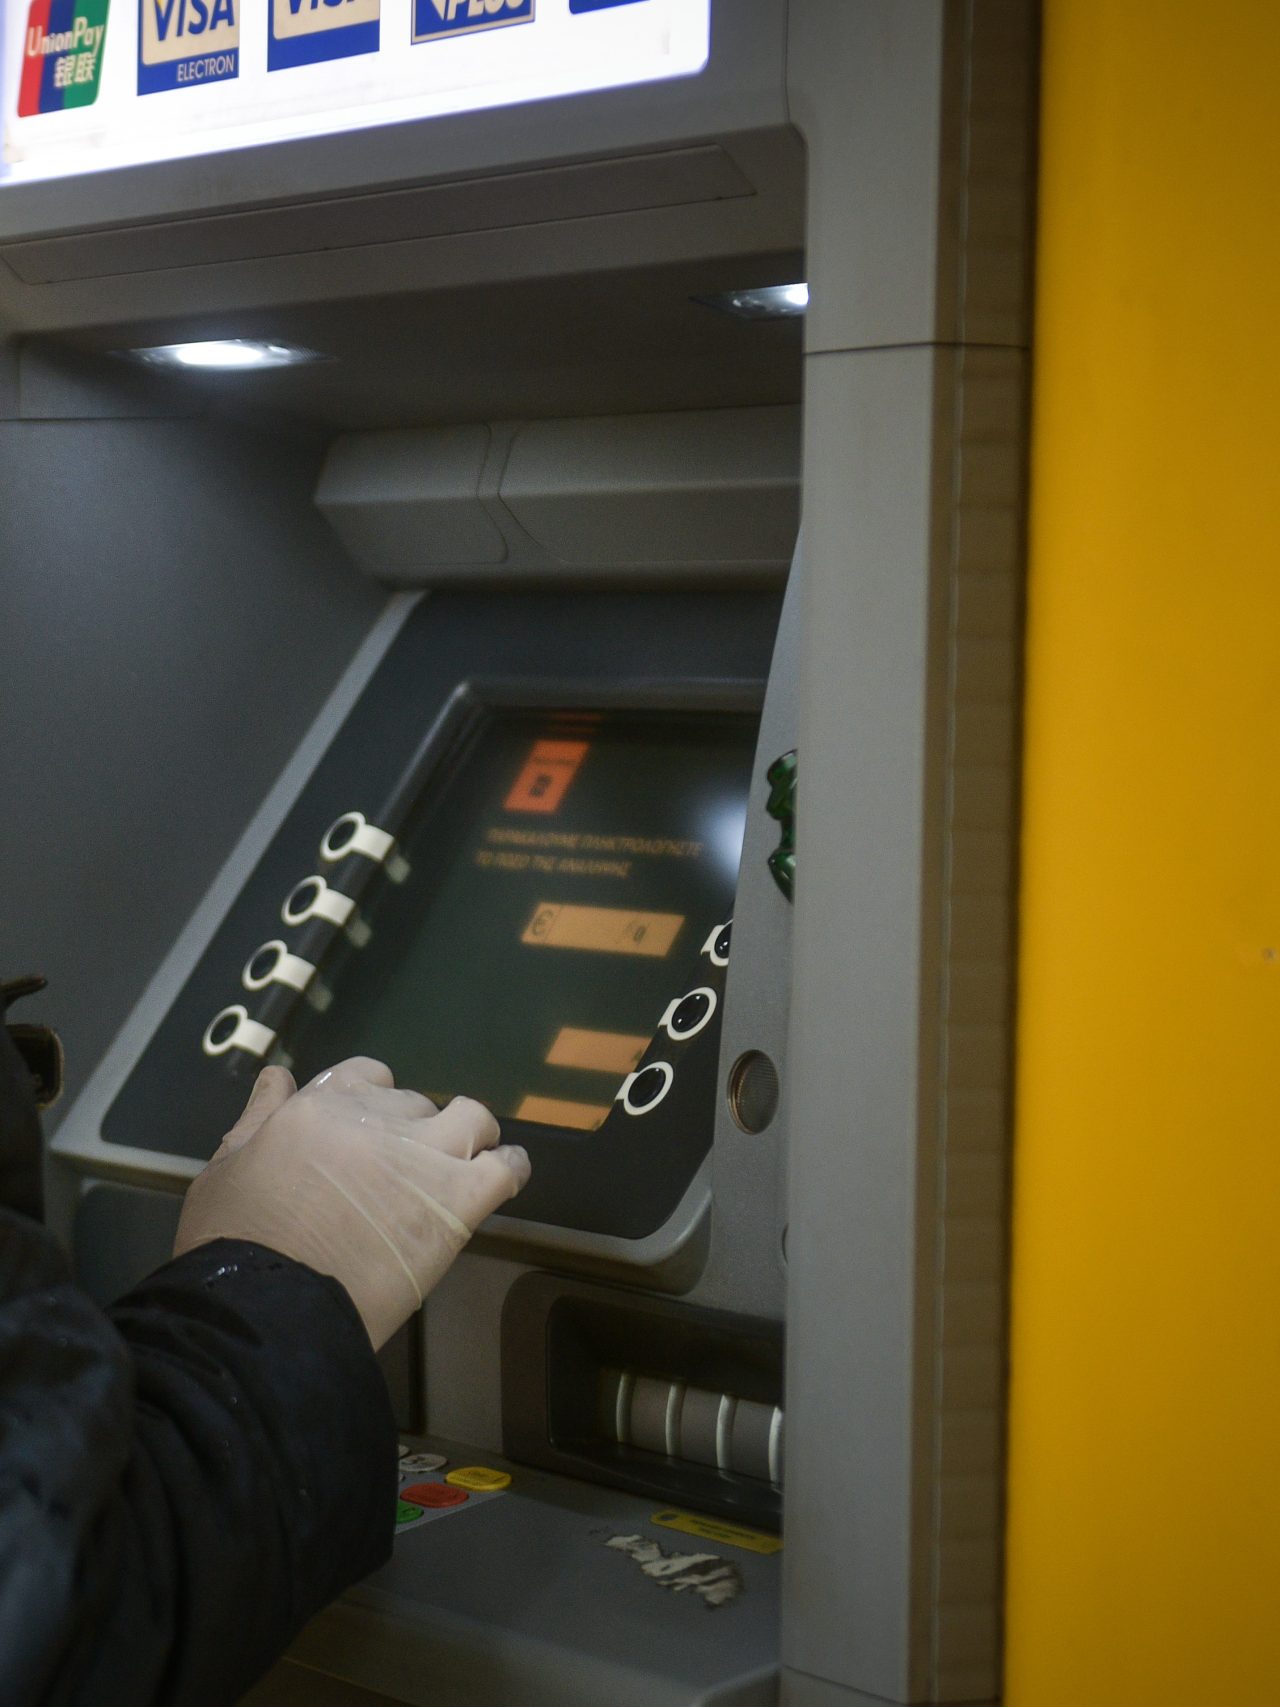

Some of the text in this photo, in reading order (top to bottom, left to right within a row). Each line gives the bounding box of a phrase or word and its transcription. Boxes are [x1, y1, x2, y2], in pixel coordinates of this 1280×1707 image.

[27, 16, 104, 57] UnionPay
[154, 0, 235, 42] VISA
[54, 52, 96, 87] 银联
[177, 54, 234, 82] ELECTRON
